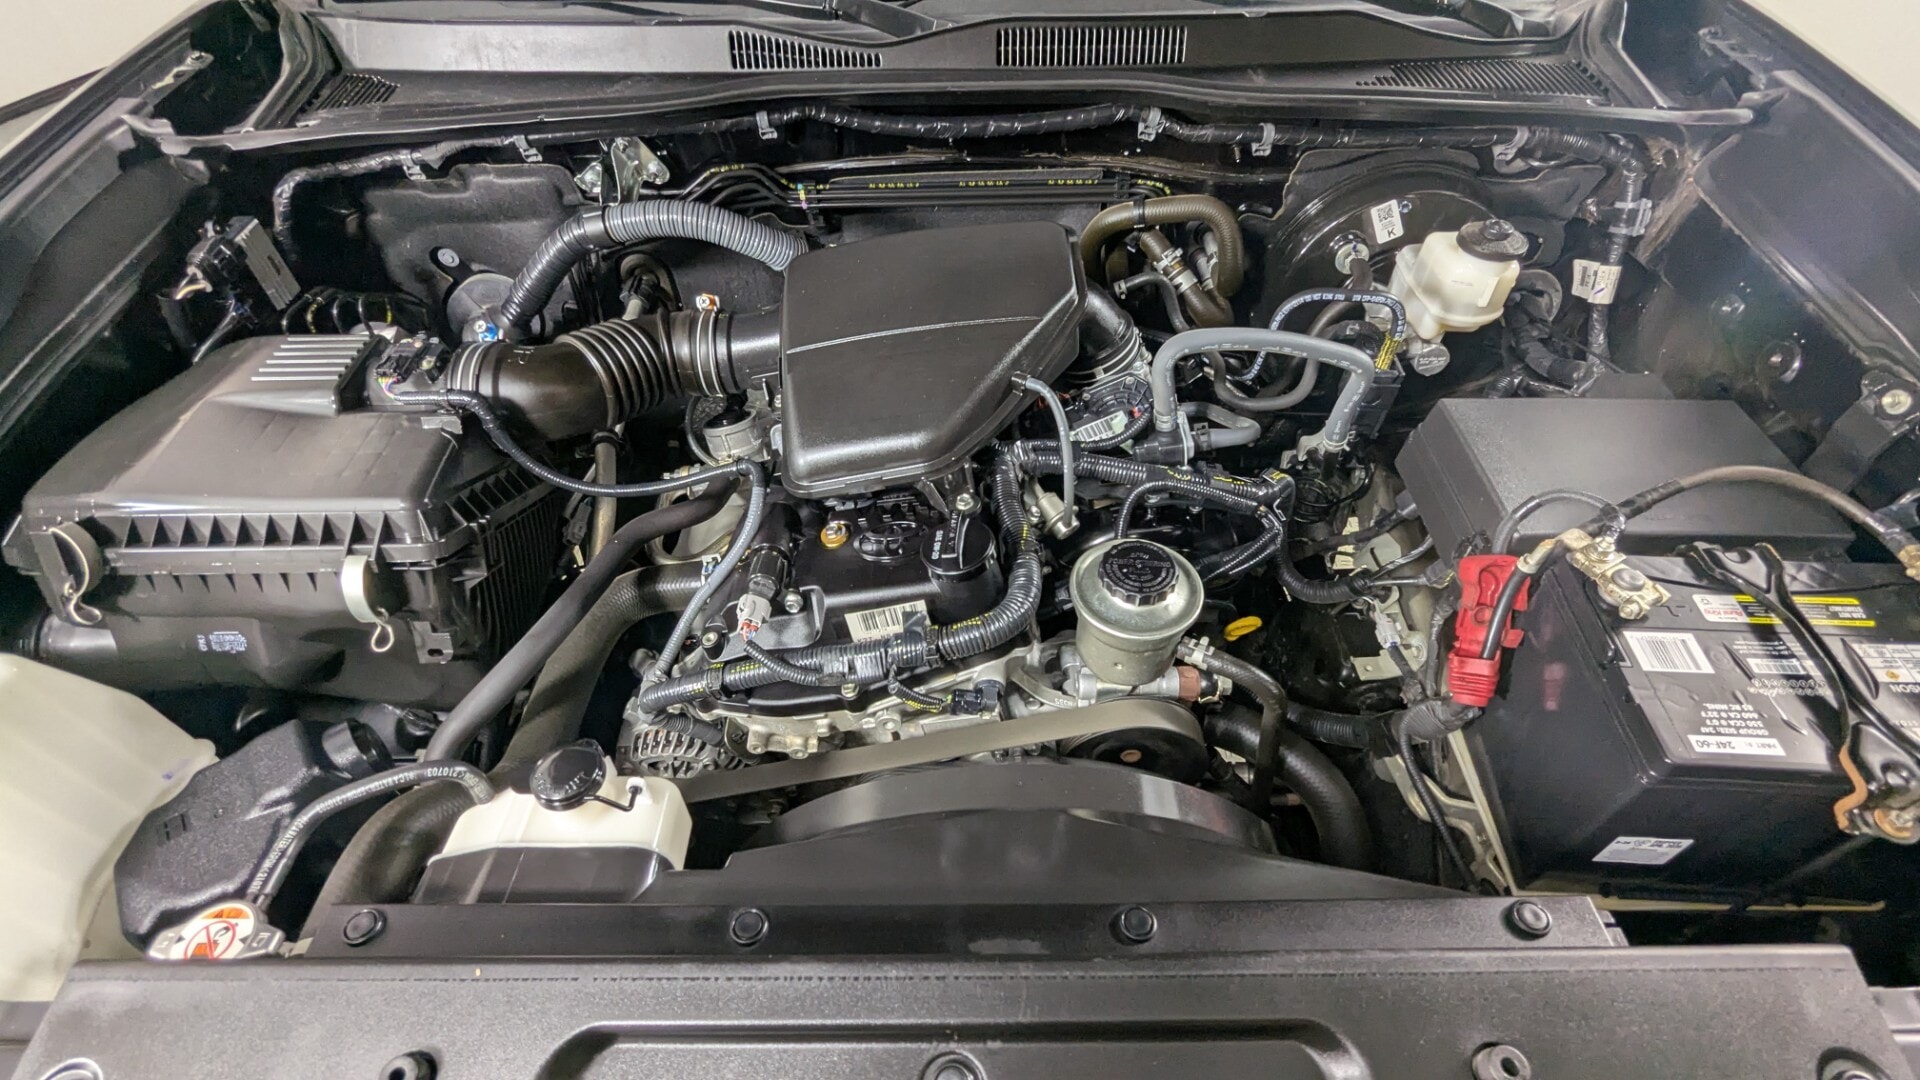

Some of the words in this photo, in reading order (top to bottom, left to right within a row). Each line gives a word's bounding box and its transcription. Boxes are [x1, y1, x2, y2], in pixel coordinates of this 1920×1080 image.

[1387, 227, 1396, 238] K
[1727, 711, 1741, 719] CA
[1727, 719, 1746, 727] CCA
[1716, 727, 1738, 735] SIZE:
[1738, 727, 1769, 736] GROUP
[1695, 739, 1736, 750] 24F-60
